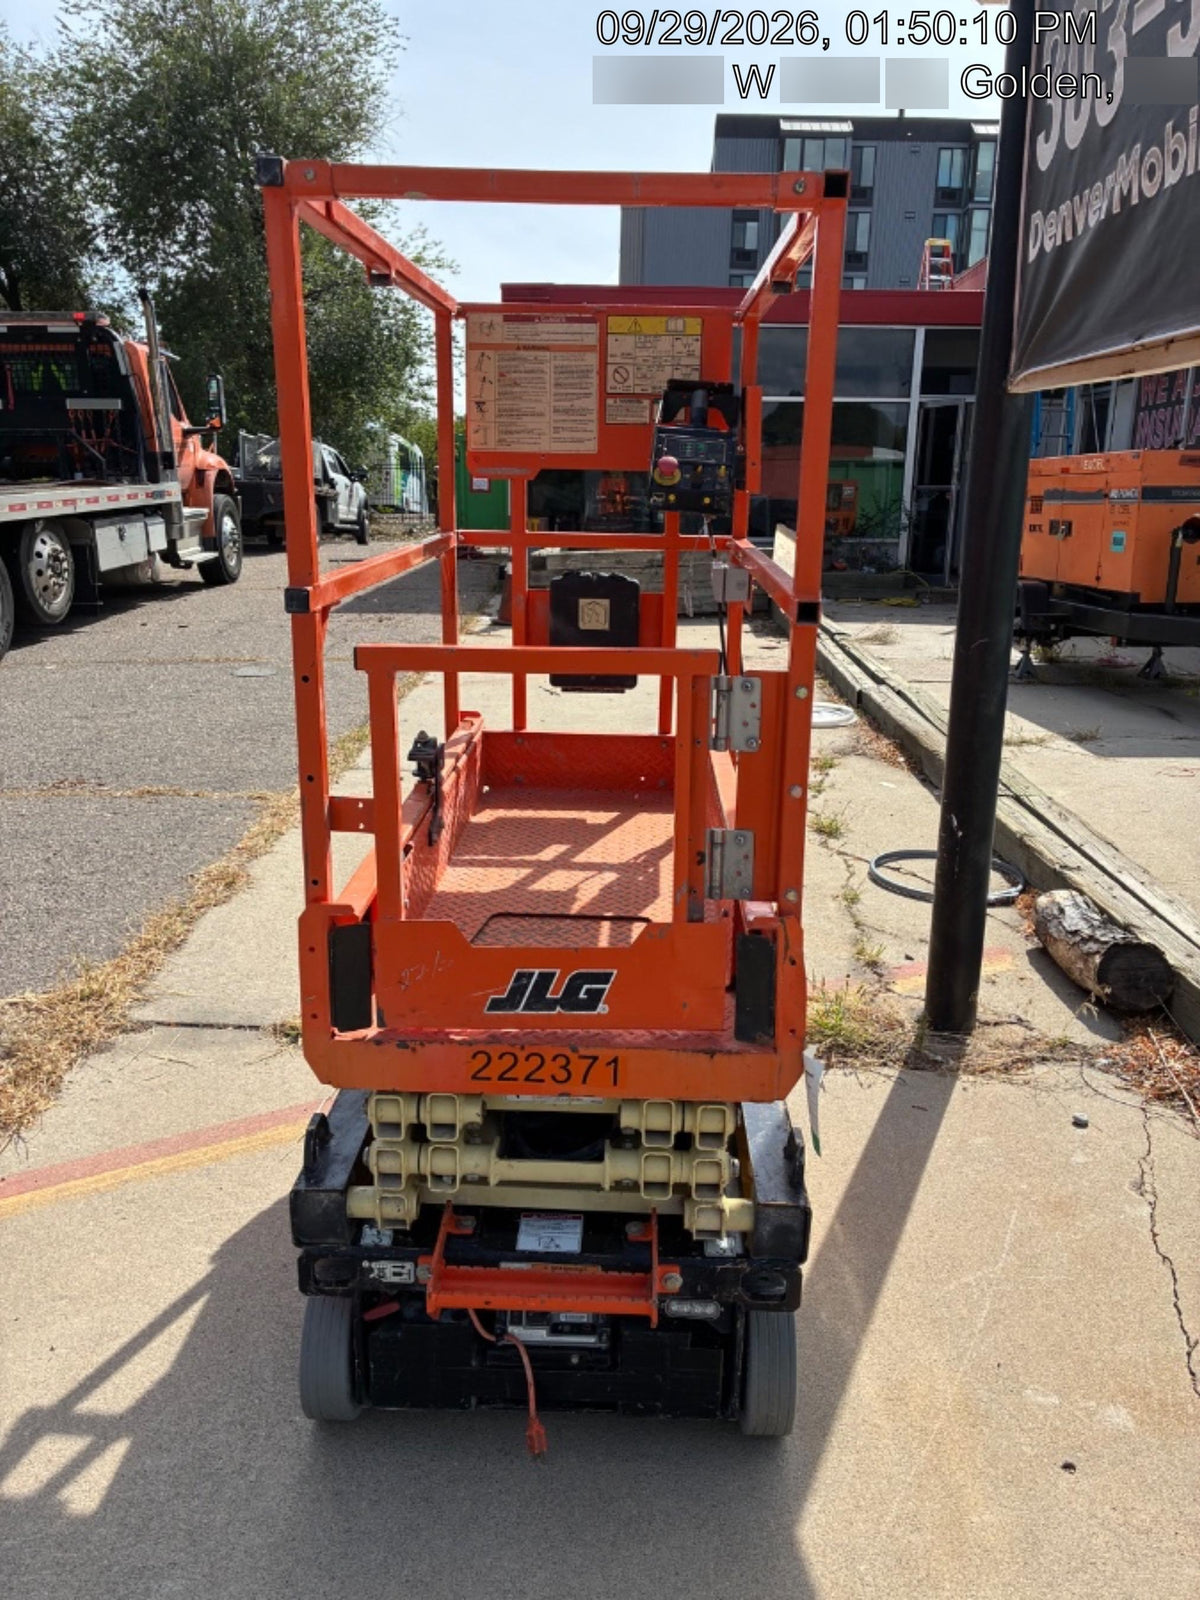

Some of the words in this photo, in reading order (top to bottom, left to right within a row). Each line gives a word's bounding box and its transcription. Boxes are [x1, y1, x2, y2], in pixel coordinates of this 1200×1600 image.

[1028, 104, 1200, 264] DenverMobi
[483, 968, 618, 1014] JLG
[470, 1050, 619, 1087] 222371
